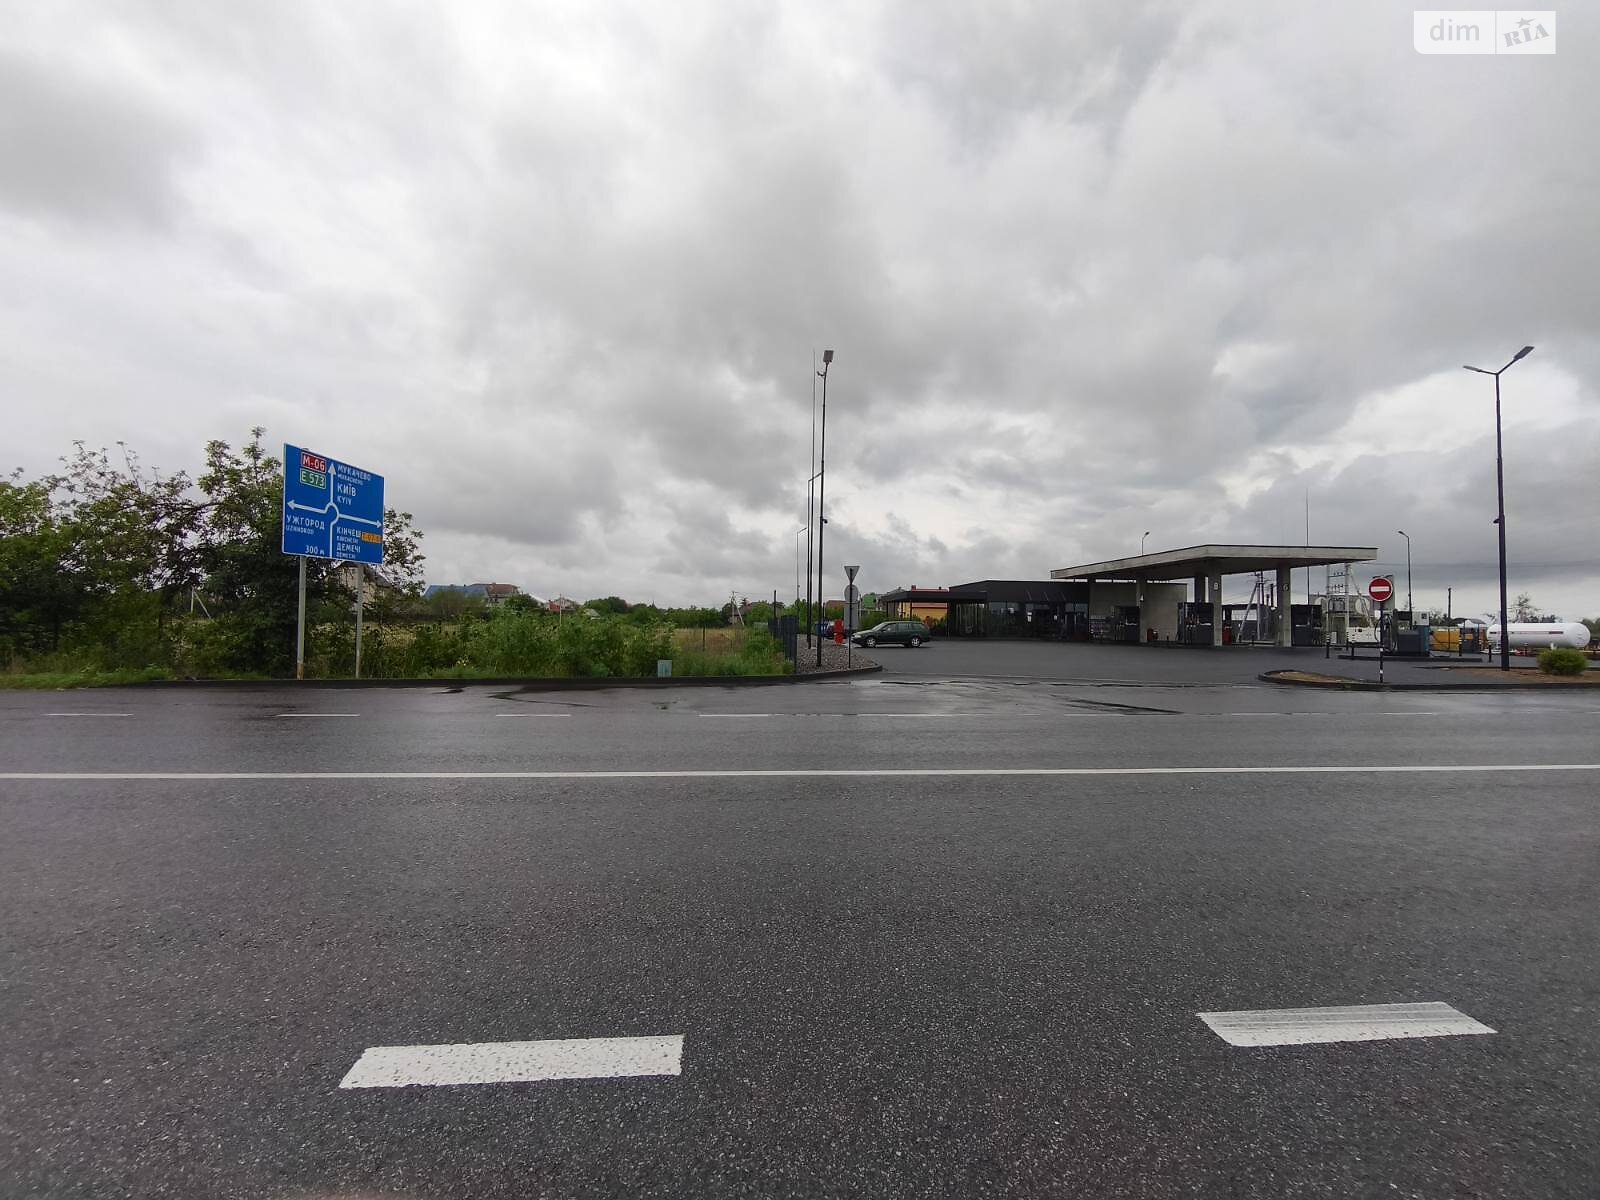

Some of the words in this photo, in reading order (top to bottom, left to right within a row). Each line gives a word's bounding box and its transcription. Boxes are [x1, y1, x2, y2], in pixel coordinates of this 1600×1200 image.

[309, 473, 325, 487] 573
[337, 482, 356, 497] КИЇВ
[337, 495, 352, 505] KYIV
[286, 514, 325, 531] УЖГОРОД
[305, 544, 319, 555] 300
[336, 542, 361, 553] ДЕМЕЧІ
